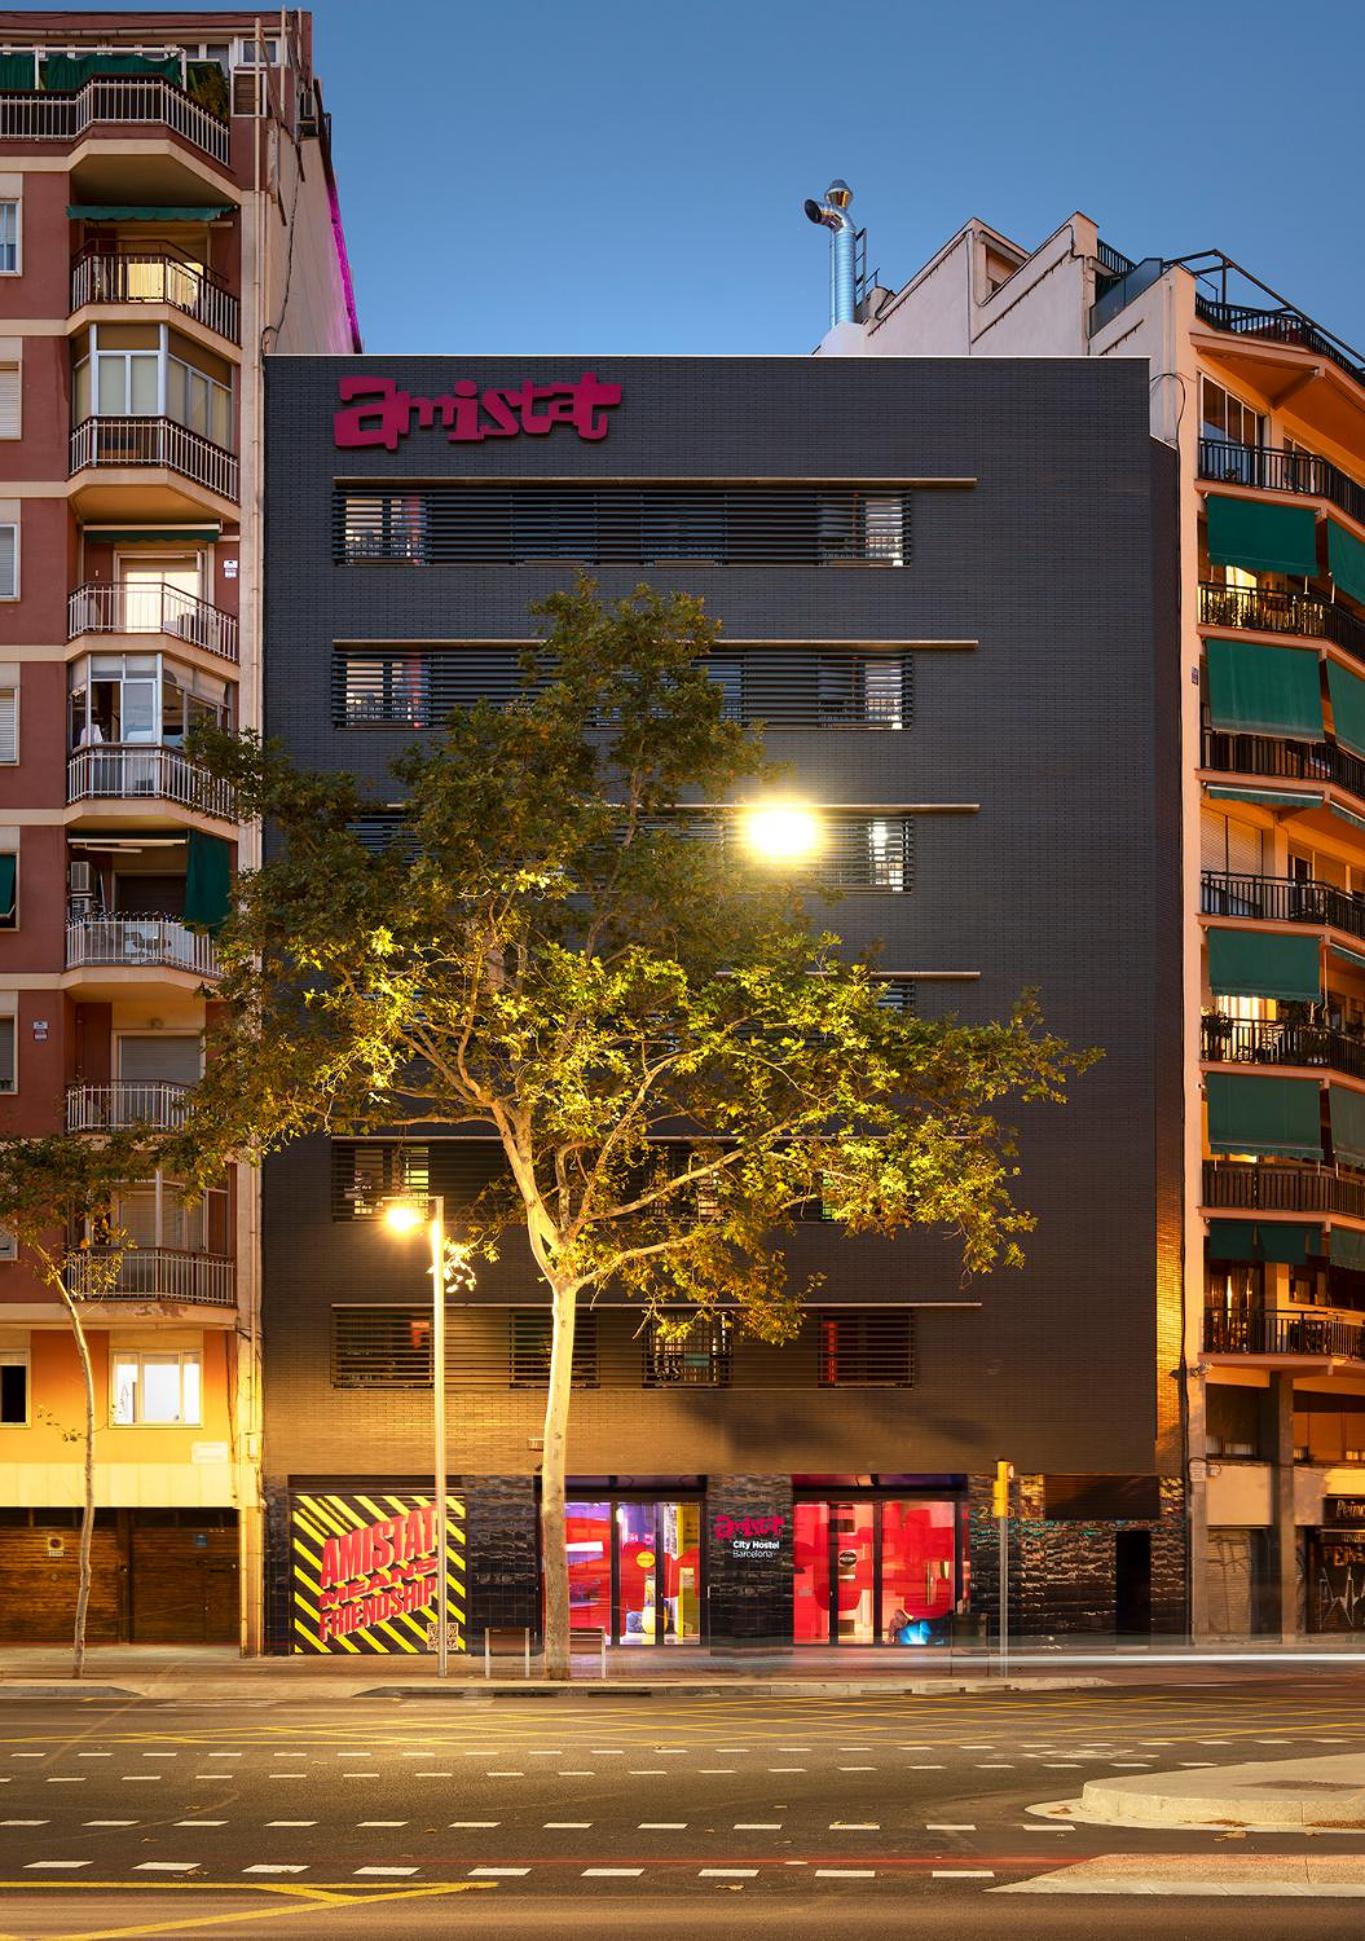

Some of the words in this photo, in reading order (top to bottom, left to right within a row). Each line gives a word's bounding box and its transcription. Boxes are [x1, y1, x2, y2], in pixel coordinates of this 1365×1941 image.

[333, 371, 622, 450] amistat
[320, 1504, 438, 1589] AMISTAT
[732, 1550, 774, 1558] Barcelona
[733, 1540, 750, 1550] City
[752, 1541, 780, 1549] Hostel
[318, 1557, 438, 1609] MEANS
[319, 1577, 438, 1642] FRIENDSHIP
